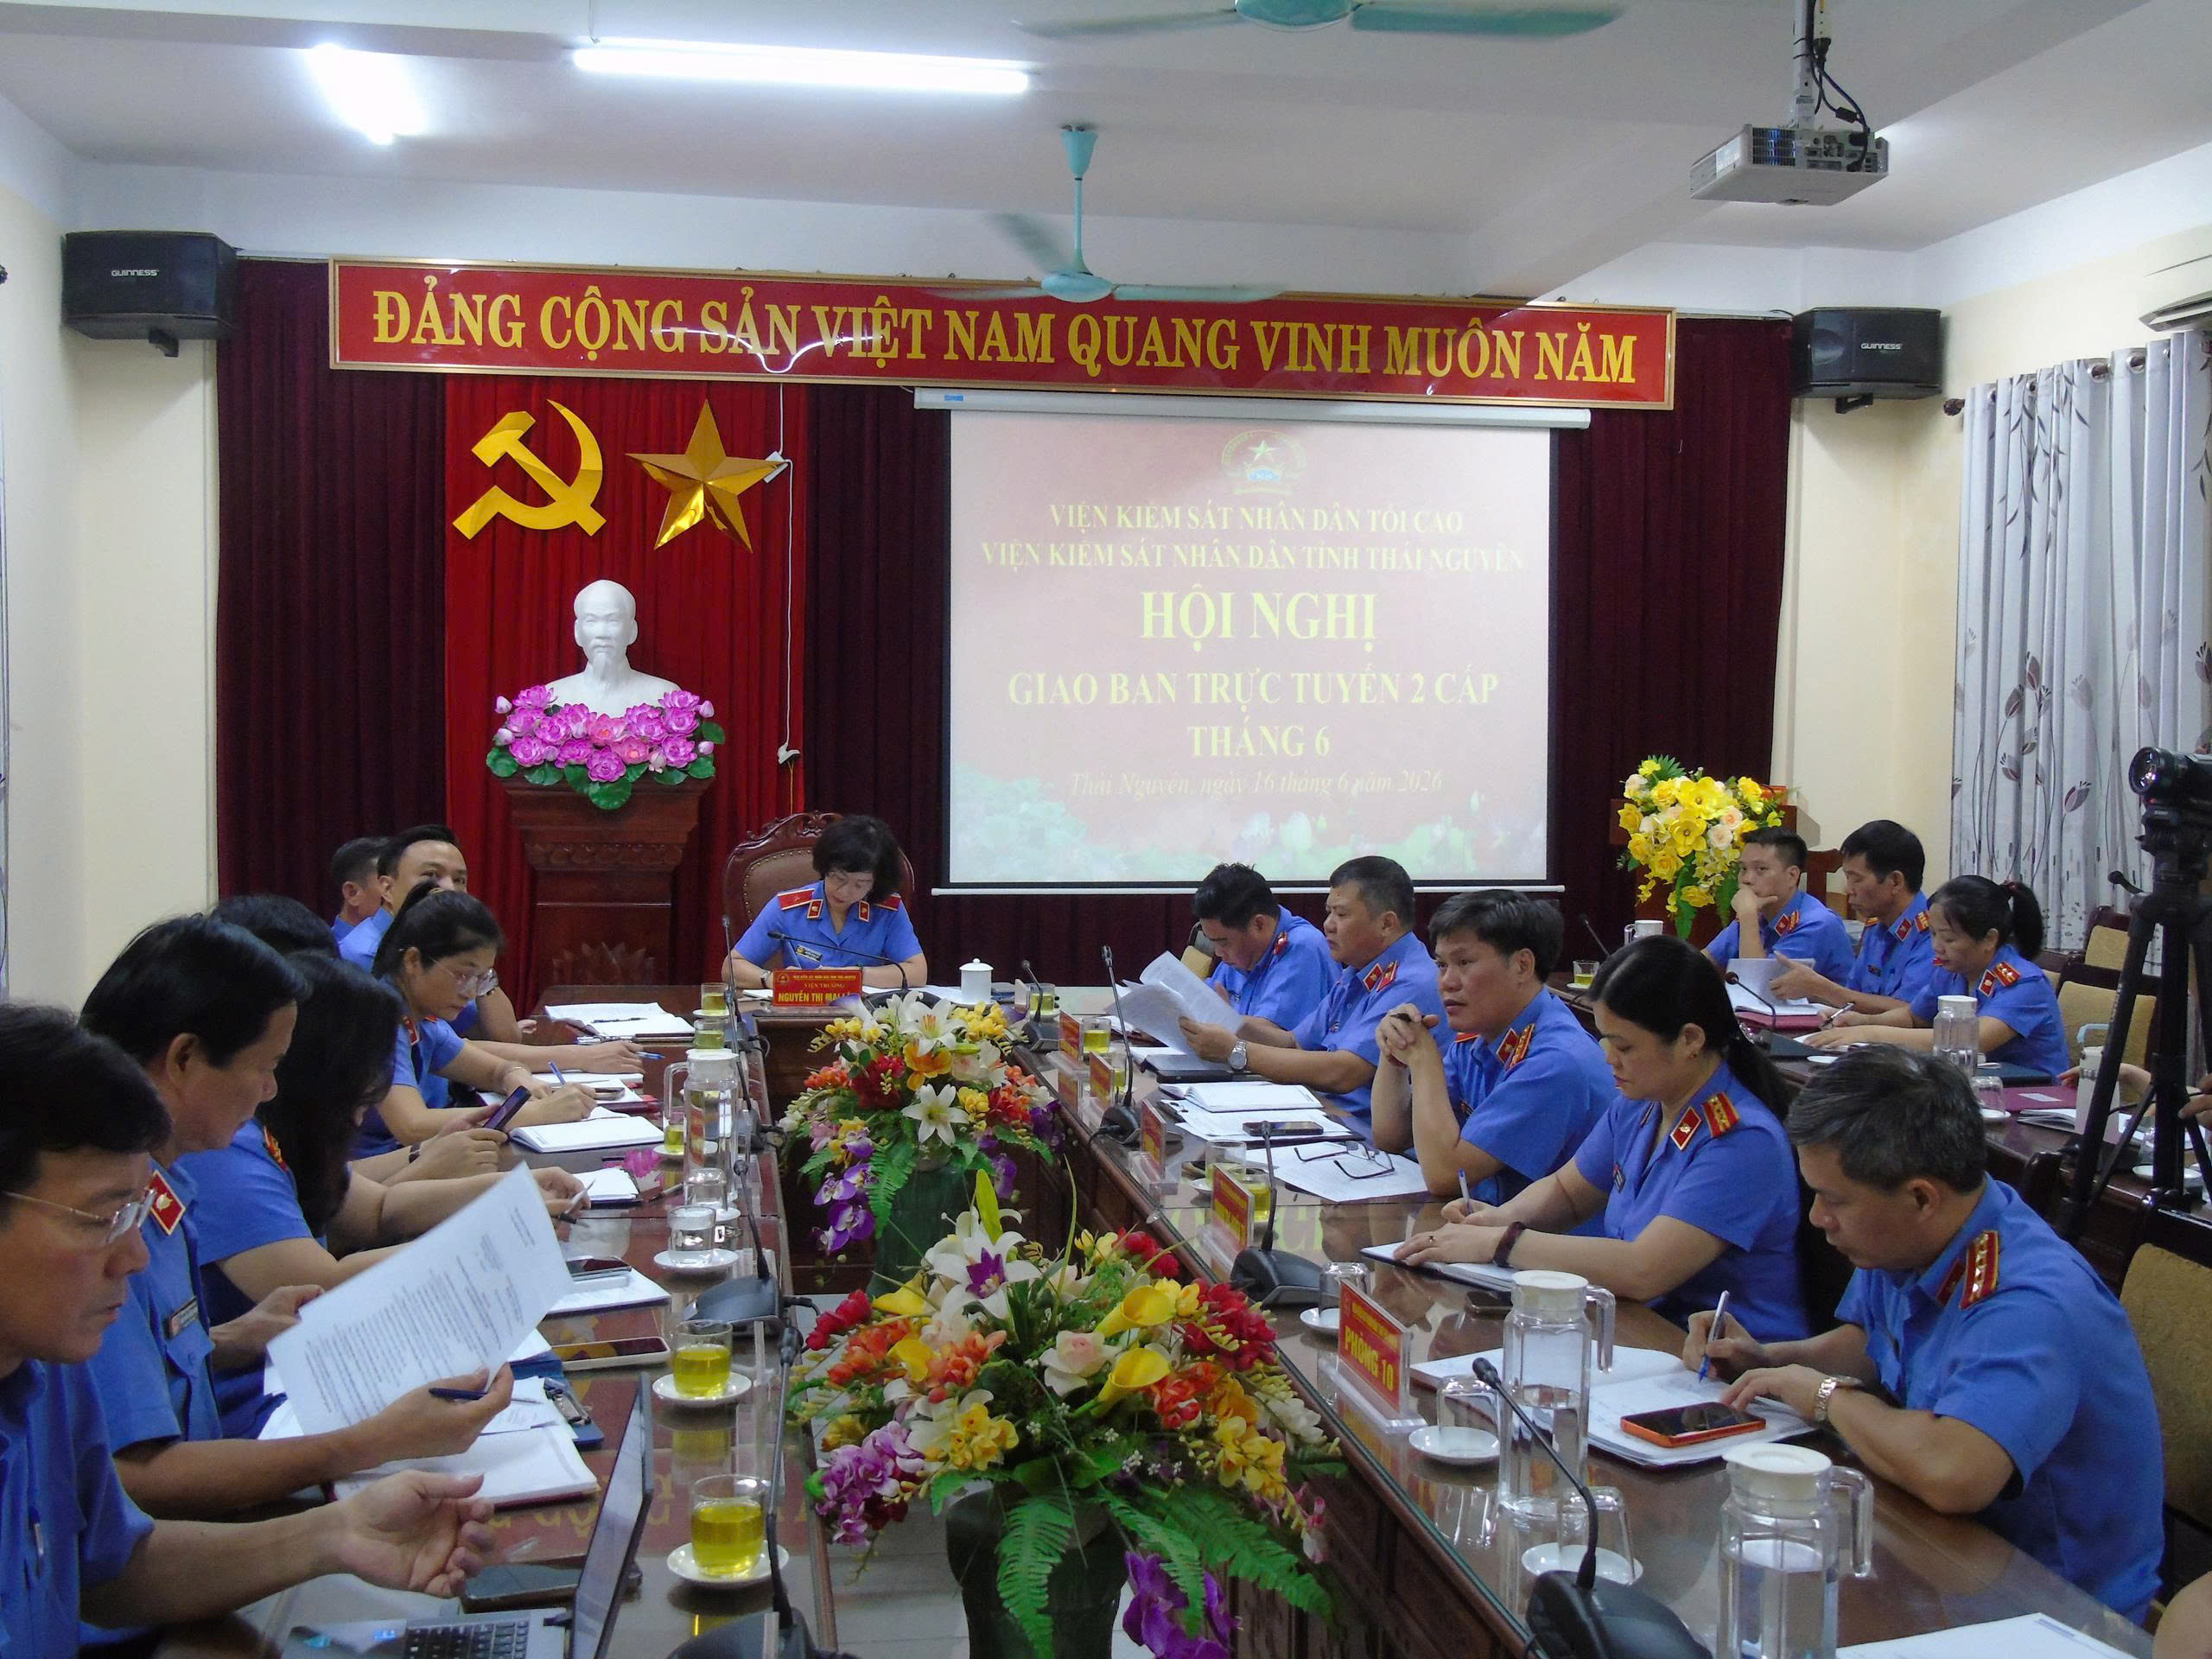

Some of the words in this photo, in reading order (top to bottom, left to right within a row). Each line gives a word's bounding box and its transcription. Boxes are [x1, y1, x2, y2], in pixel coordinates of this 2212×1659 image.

[111, 269, 158, 277] GUINNESS
[372, 276, 525, 348] ĐẢNG
[539, 285, 685, 361] CỘNG
[700, 286, 801, 356] SẢN
[810, 295, 931, 369] VIỆT
[944, 308, 1055, 364] NAM
[1067, 313, 1237, 378] QUANG
[1249, 320, 1372, 374] VINH
[1383, 317, 1525, 381] MUÔN
[1535, 322, 1637, 384] NĂM
[1050, 500, 1108, 534] VIỆN
[1187, 499, 1232, 530] SÁT
[1240, 500, 1305, 531] NHÂN
[1313, 502, 1360, 532] DÂN
[1414, 510, 1463, 533] CAO
[982, 538, 1041, 573] VIỆN
[1121, 537, 1166, 567] SÁT
[1173, 538, 1241, 568] NHÂN
[1249, 539, 1297, 569] DÂN
[1365, 540, 1423, 570] THÁI
[1140, 583, 1236, 652] HỘI
[1250, 592, 1377, 653] NGHỊ
[1008, 671, 1098, 705] GIAO
[1109, 671, 1177, 705] BAN
[1188, 667, 1281, 713] TRỰC
[1291, 663, 1401, 705] TUYẾN
[1411, 672, 1425, 704] 2
[1434, 663, 1500, 706] CẤP
[1187, 715, 1305, 757] THÁNG
[1314, 725, 1330, 757] 6
[1254, 771, 1274, 792] 16
[1338, 771, 1348, 790] 6
[1382, 1359, 1394, 1391] 10
